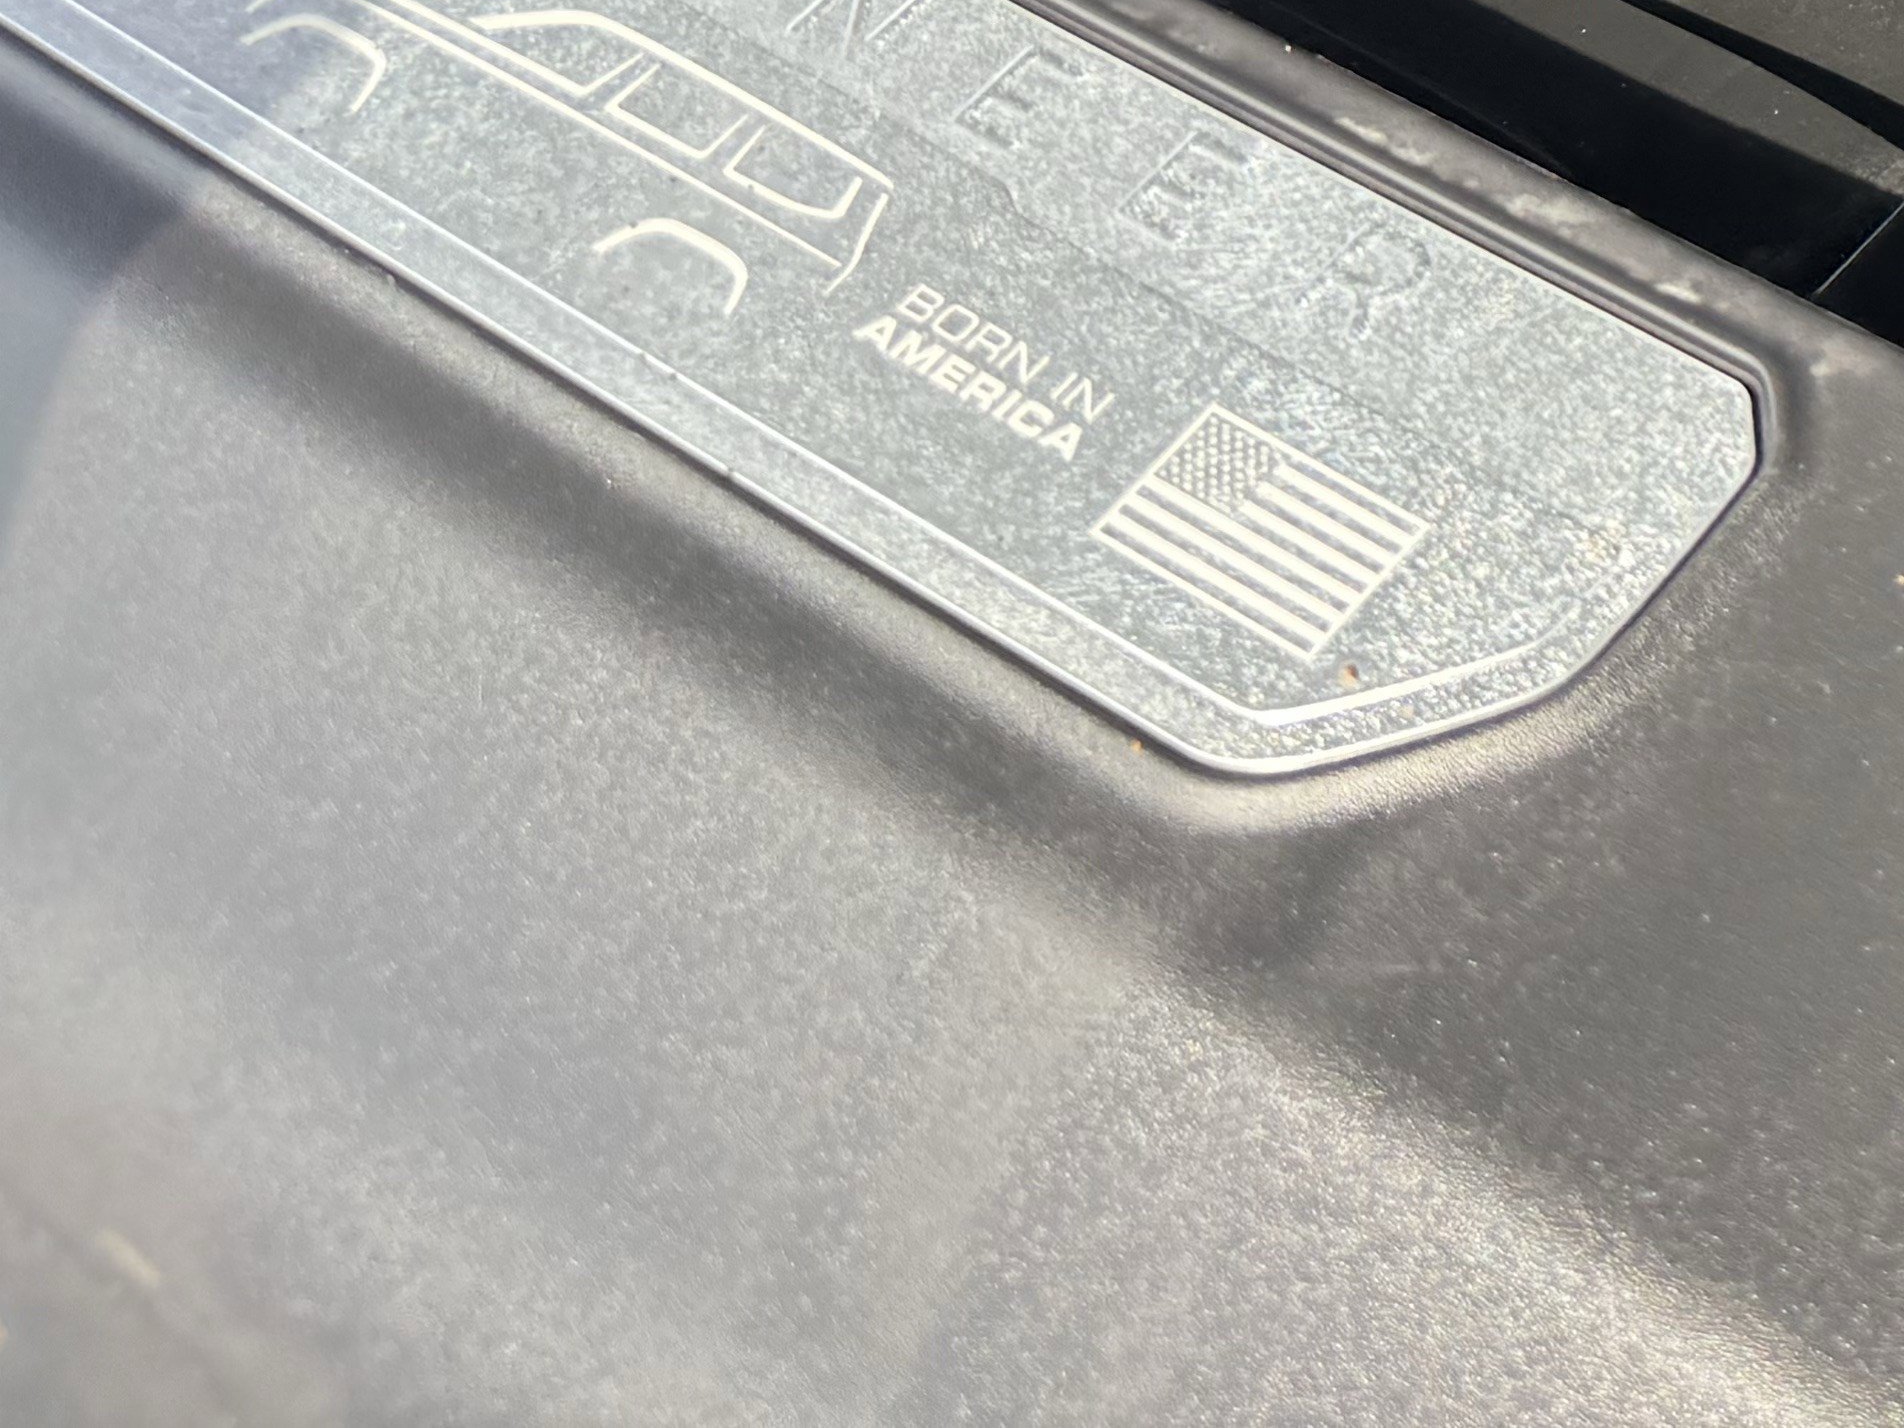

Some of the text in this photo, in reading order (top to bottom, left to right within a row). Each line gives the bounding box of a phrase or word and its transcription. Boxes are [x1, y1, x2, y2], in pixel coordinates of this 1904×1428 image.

[854, 314, 1084, 462] AMERICA
[897, 282, 1115, 423] BORN IN
